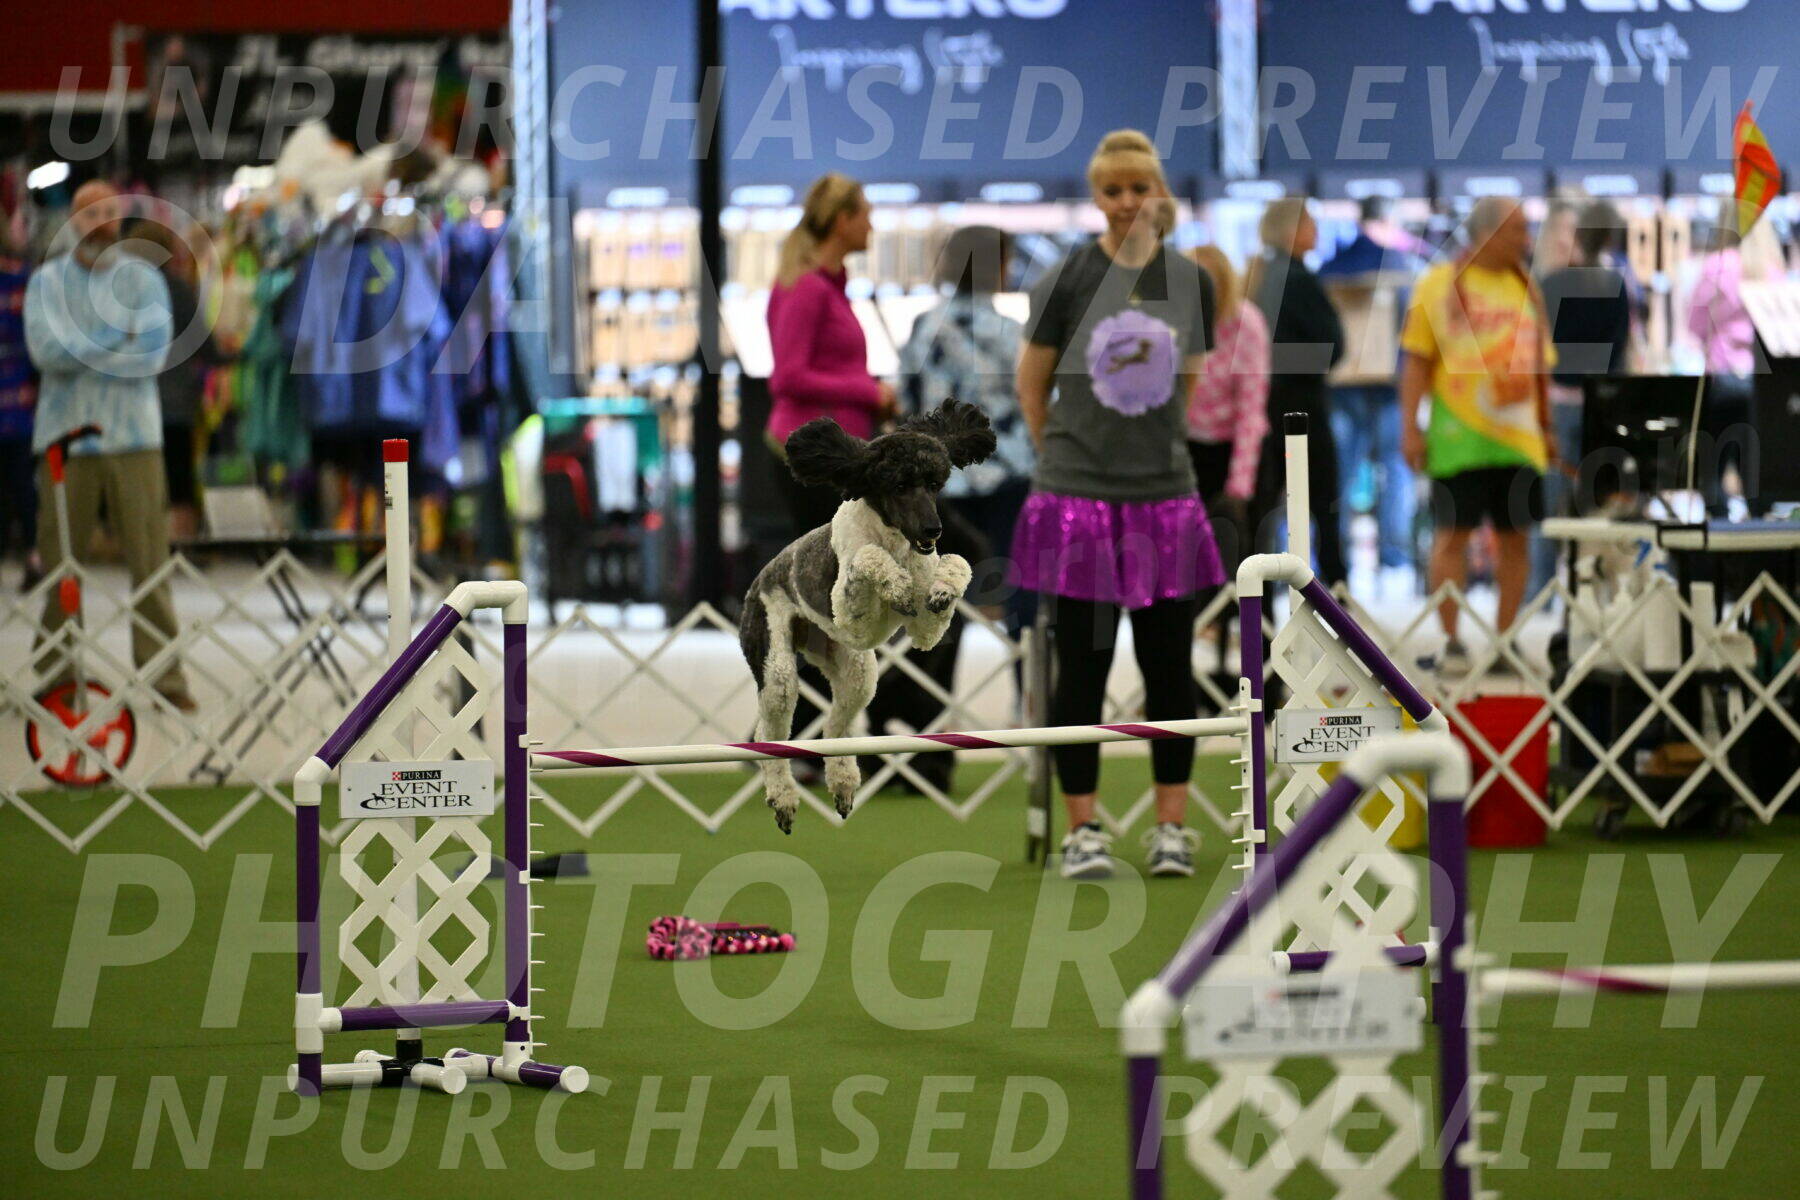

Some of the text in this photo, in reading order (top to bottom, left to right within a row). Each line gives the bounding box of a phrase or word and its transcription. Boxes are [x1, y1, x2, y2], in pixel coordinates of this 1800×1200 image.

[1328, 716, 1362, 725] PURINA
[1310, 725, 1375, 740] EVENT
[402, 771, 440, 780] PURINA
[380, 780, 457, 796] EVENT
[360, 794, 473, 810] CENTER
